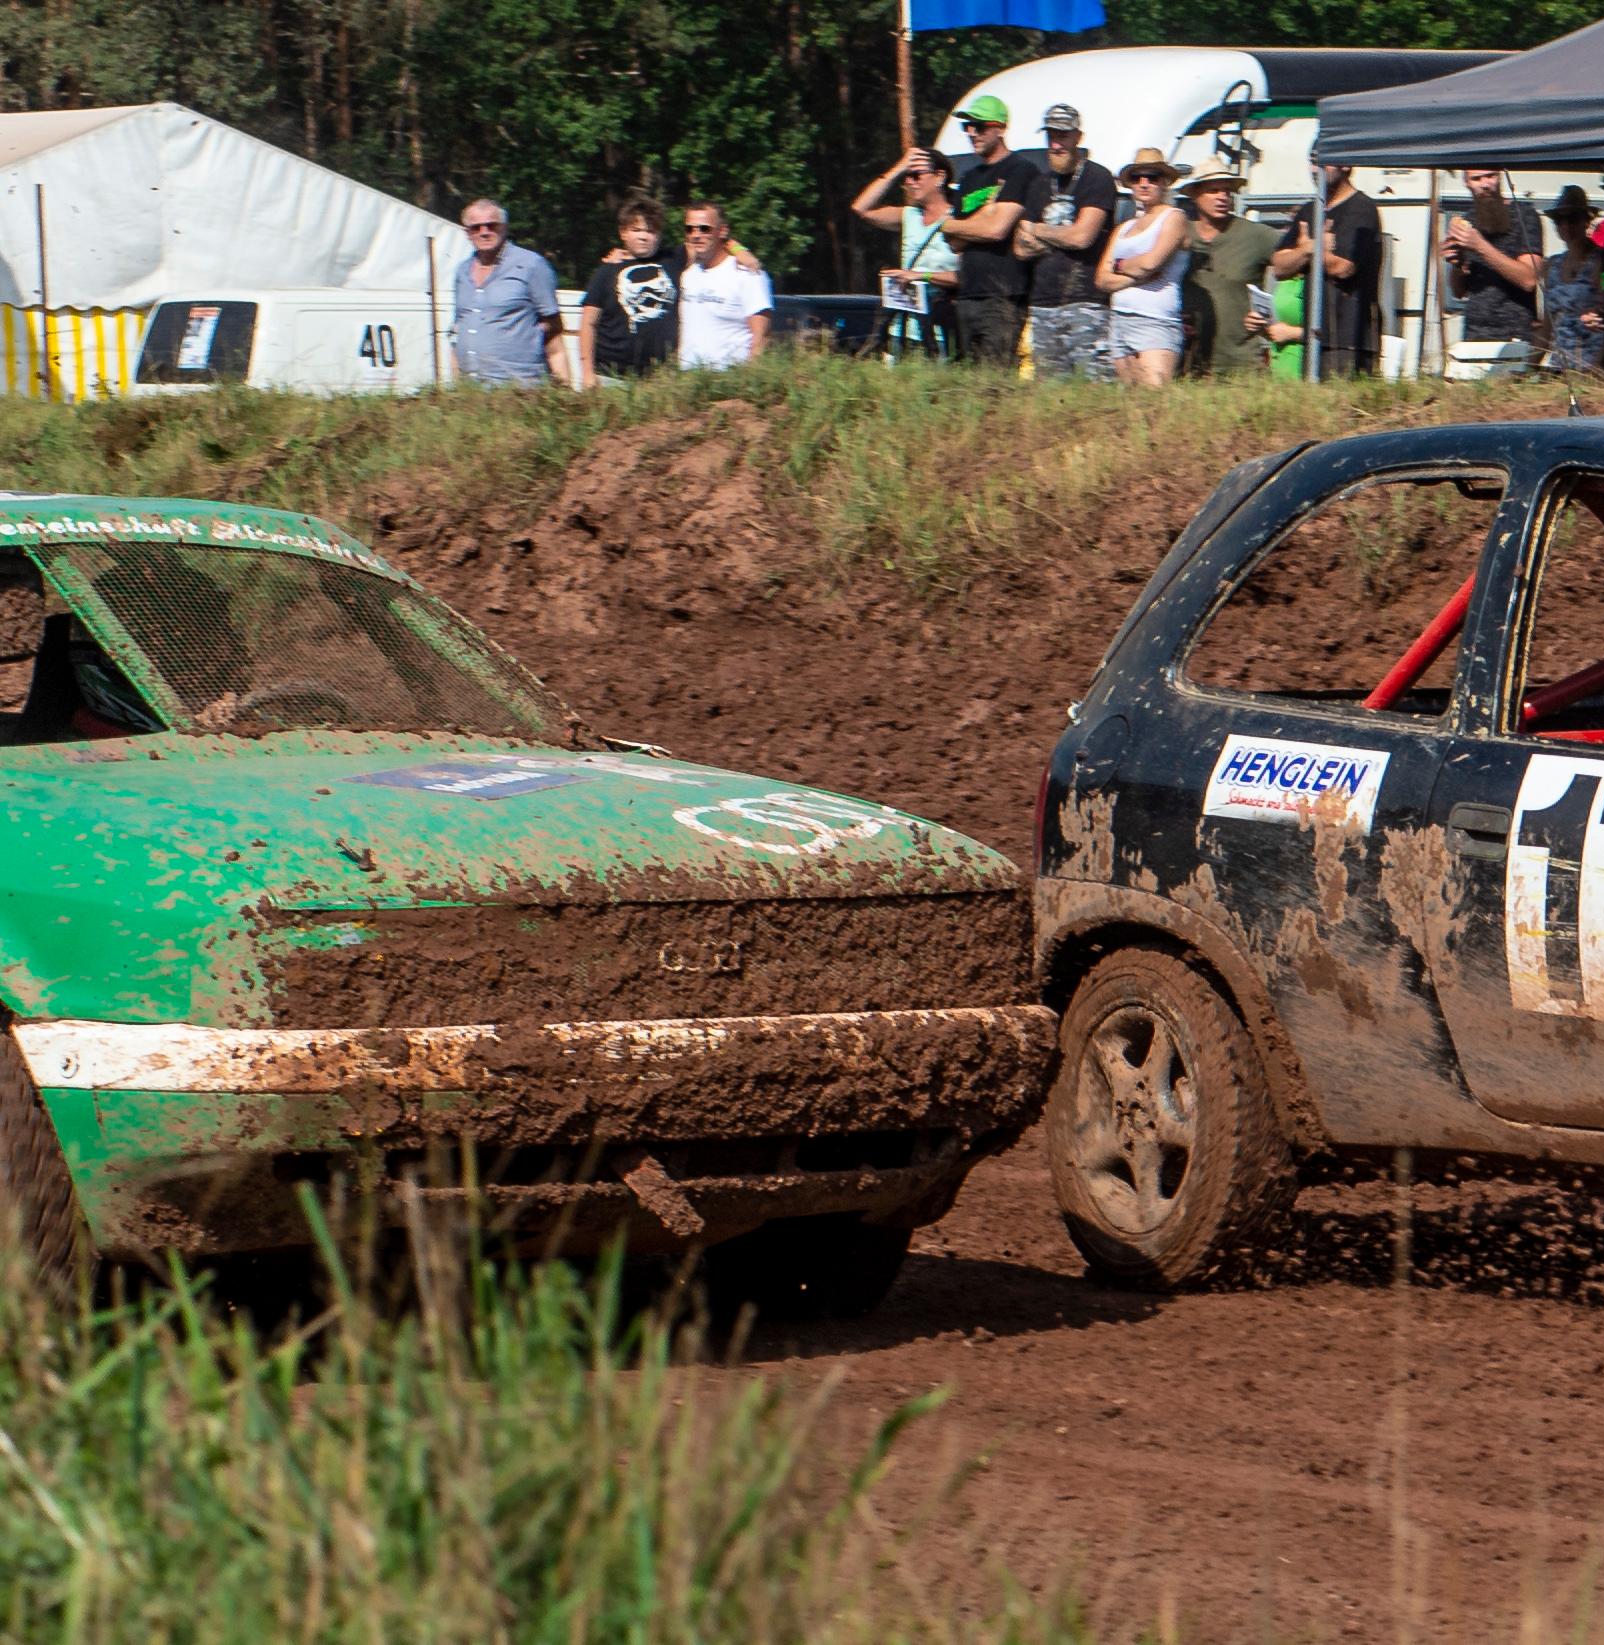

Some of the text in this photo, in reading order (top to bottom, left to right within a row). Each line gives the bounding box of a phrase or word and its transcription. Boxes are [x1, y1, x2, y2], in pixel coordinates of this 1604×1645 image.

[360, 324, 397, 367] 40
[0, 515, 202, 537] emeinschaft
[1218, 748, 1370, 796] HENGLEIN
